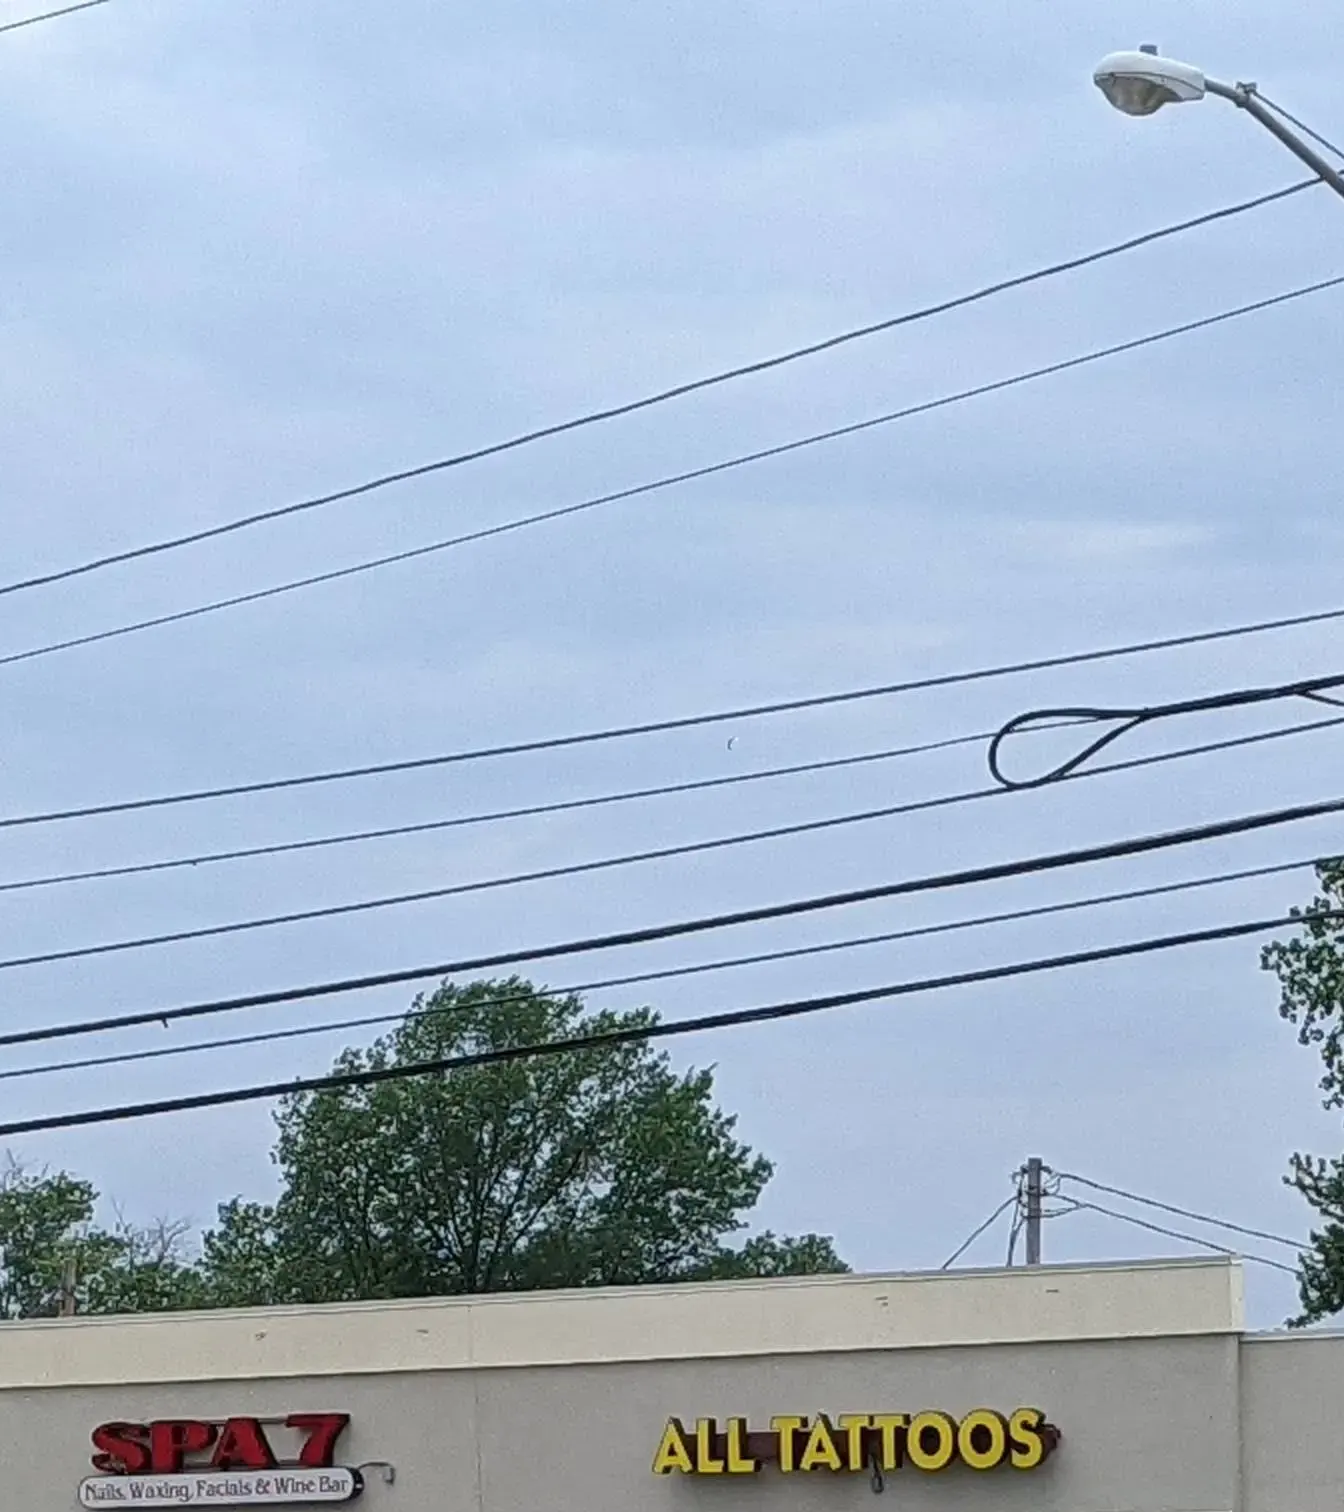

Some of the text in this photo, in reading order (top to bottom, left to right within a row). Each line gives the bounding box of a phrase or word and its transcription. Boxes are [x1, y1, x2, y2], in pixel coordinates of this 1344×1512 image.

[91, 1413, 351, 1475] SPA 7
[653, 1408, 1049, 1474] ALL TATTOOS
[197, 1479, 253, 1497] Facials
[254, 1478, 271, 1496] &
[274, 1476, 316, 1495] Wine
[319, 1475, 349, 1494] Bar
